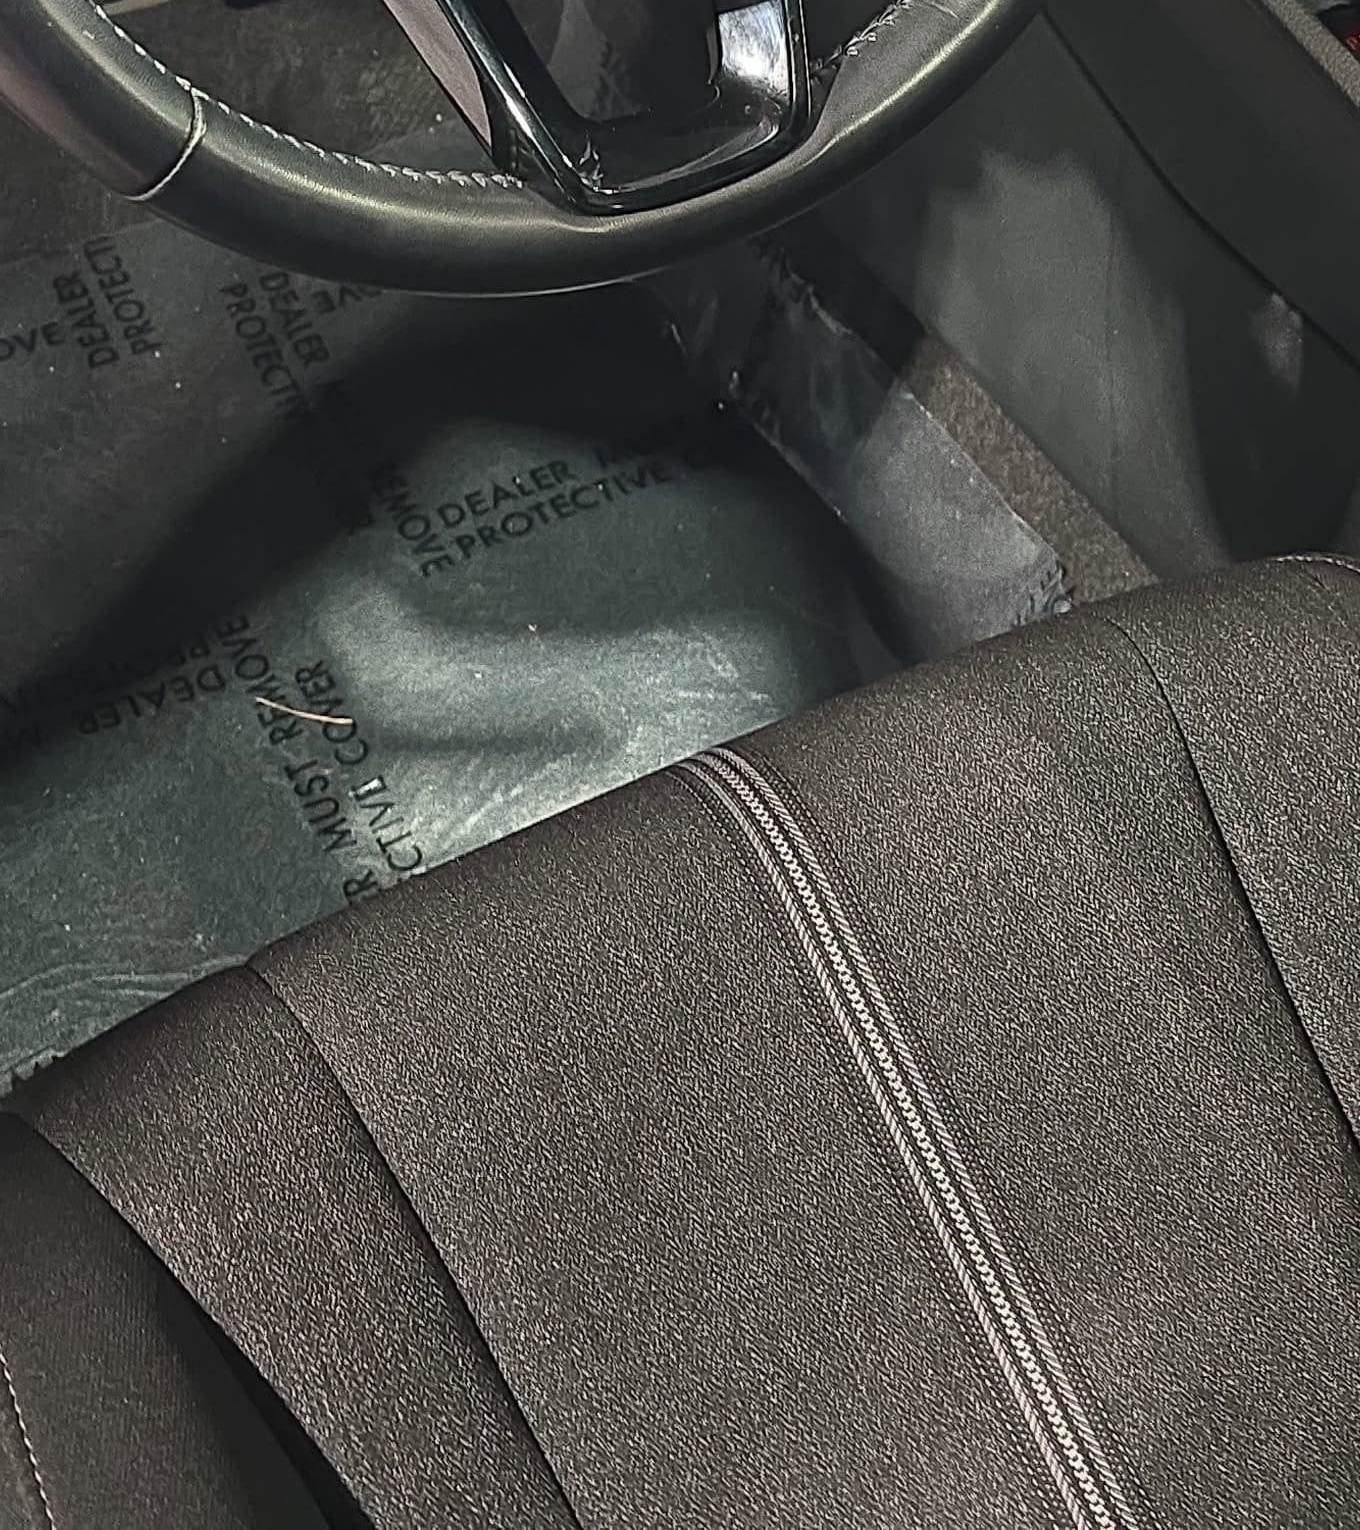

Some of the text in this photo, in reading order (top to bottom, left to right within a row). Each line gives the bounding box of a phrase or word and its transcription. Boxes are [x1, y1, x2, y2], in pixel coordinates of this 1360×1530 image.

[53, 270, 120, 370] DEALER
[258, 270, 331, 366] DEALER
[440, 459, 584, 530] DEALER
[78, 670, 226, 736] DEALER
[284, 759, 358, 853] MUST
